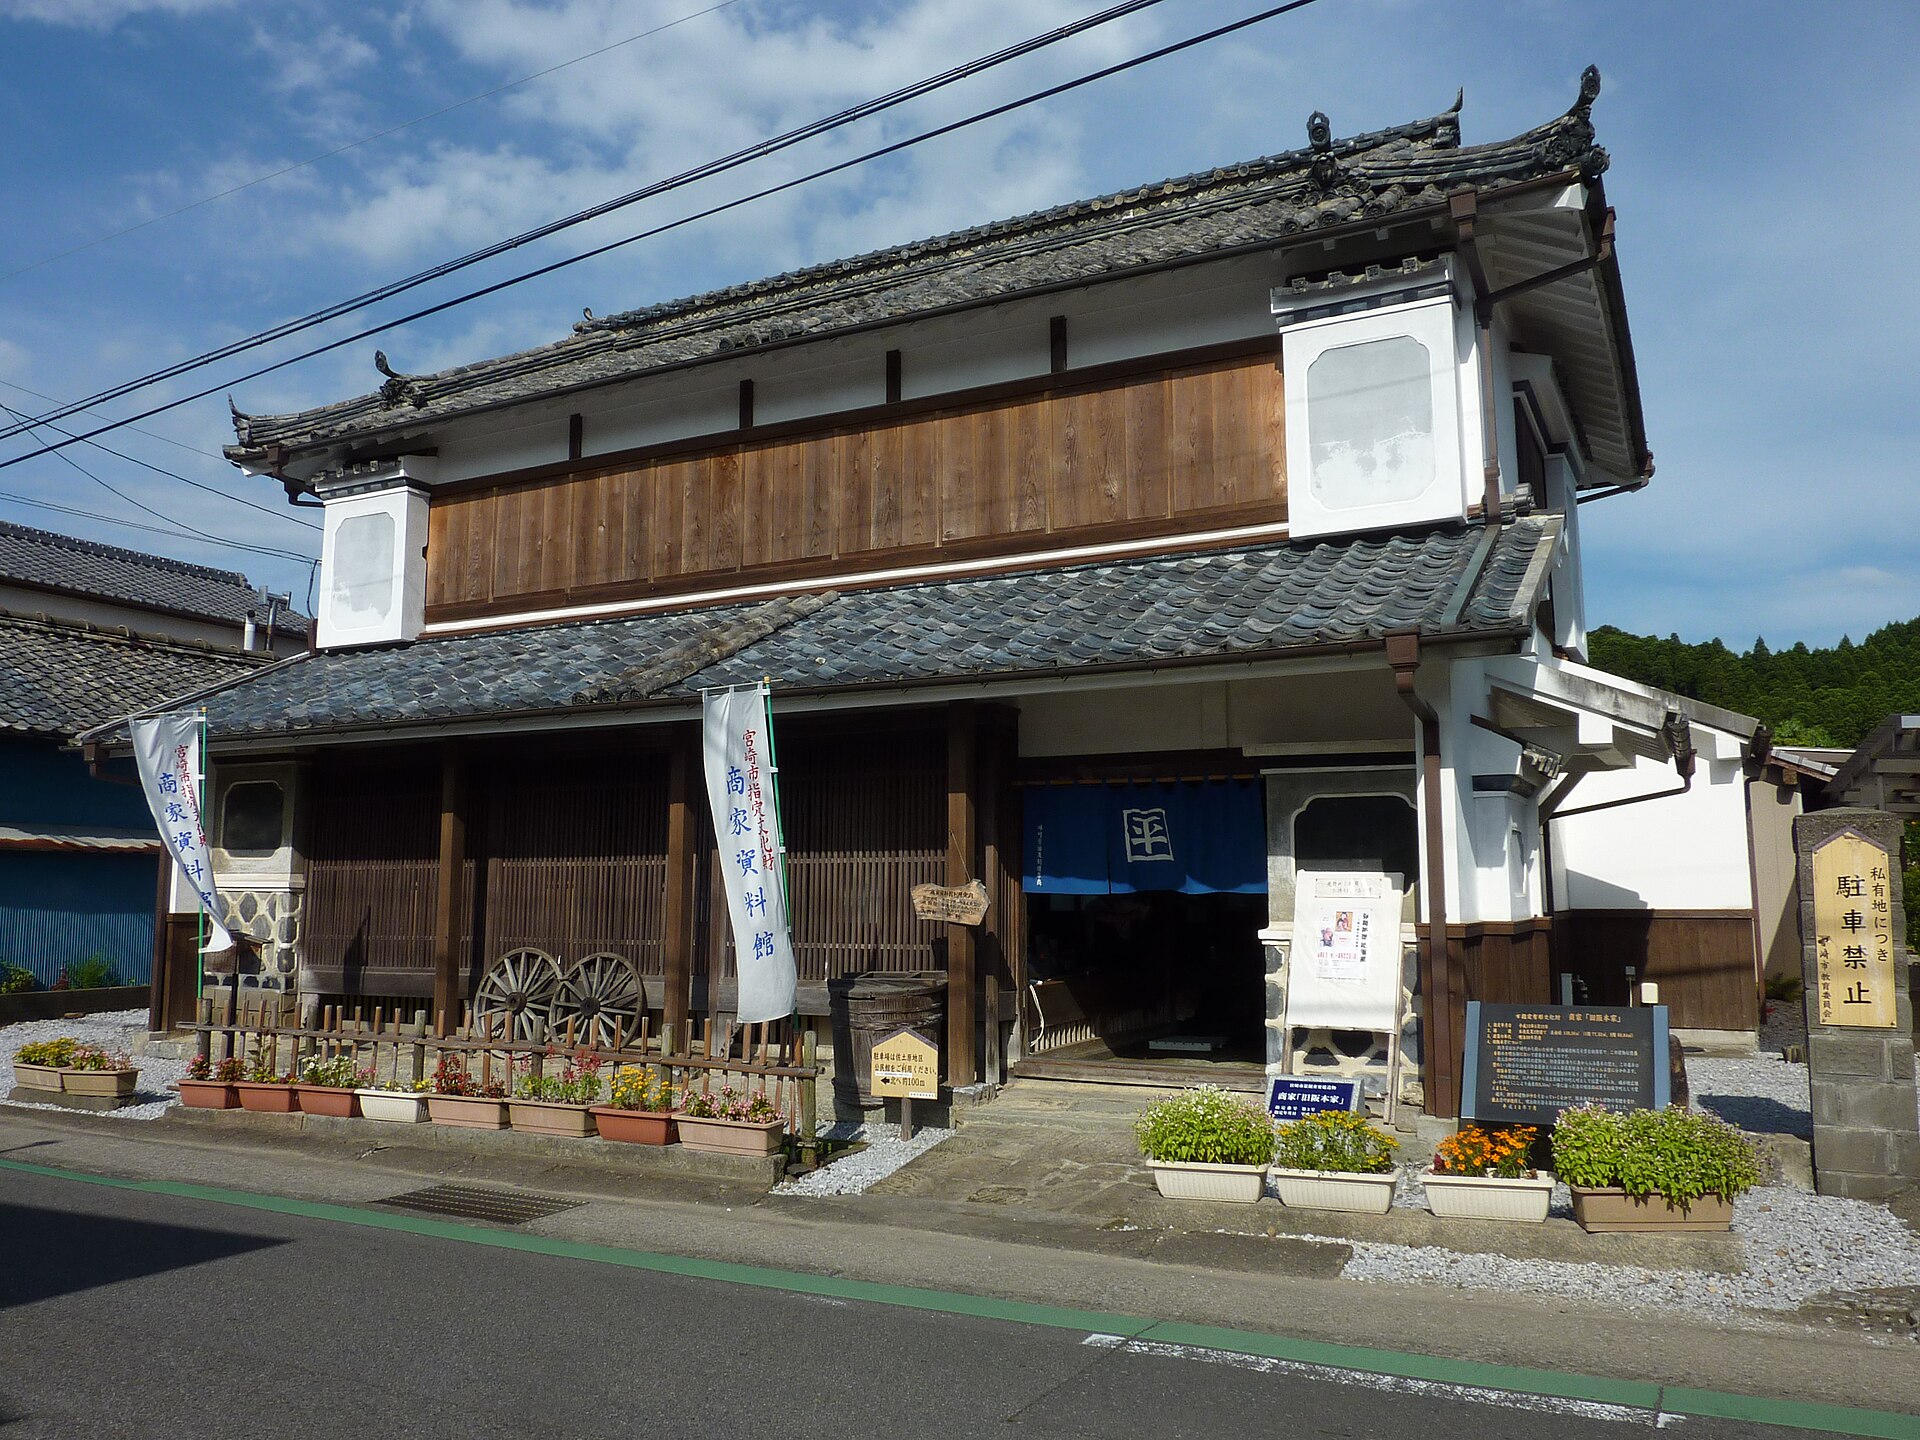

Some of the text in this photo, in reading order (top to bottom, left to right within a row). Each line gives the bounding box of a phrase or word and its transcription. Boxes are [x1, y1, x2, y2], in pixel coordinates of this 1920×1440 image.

[742, 729, 775, 871] 宮崎市指定文化財
[1129, 813, 1170, 857] 平
[726, 765, 774, 961] 商家資料館
[1836, 875, 1872, 1005] 駐車禁止
[1870, 866, 1889, 962] 私有地につき
[873, 1052, 923, 1062] 駐車場は佐土原地区
[1277, 1091, 1345, 1105] 商家「旧阪本家」
